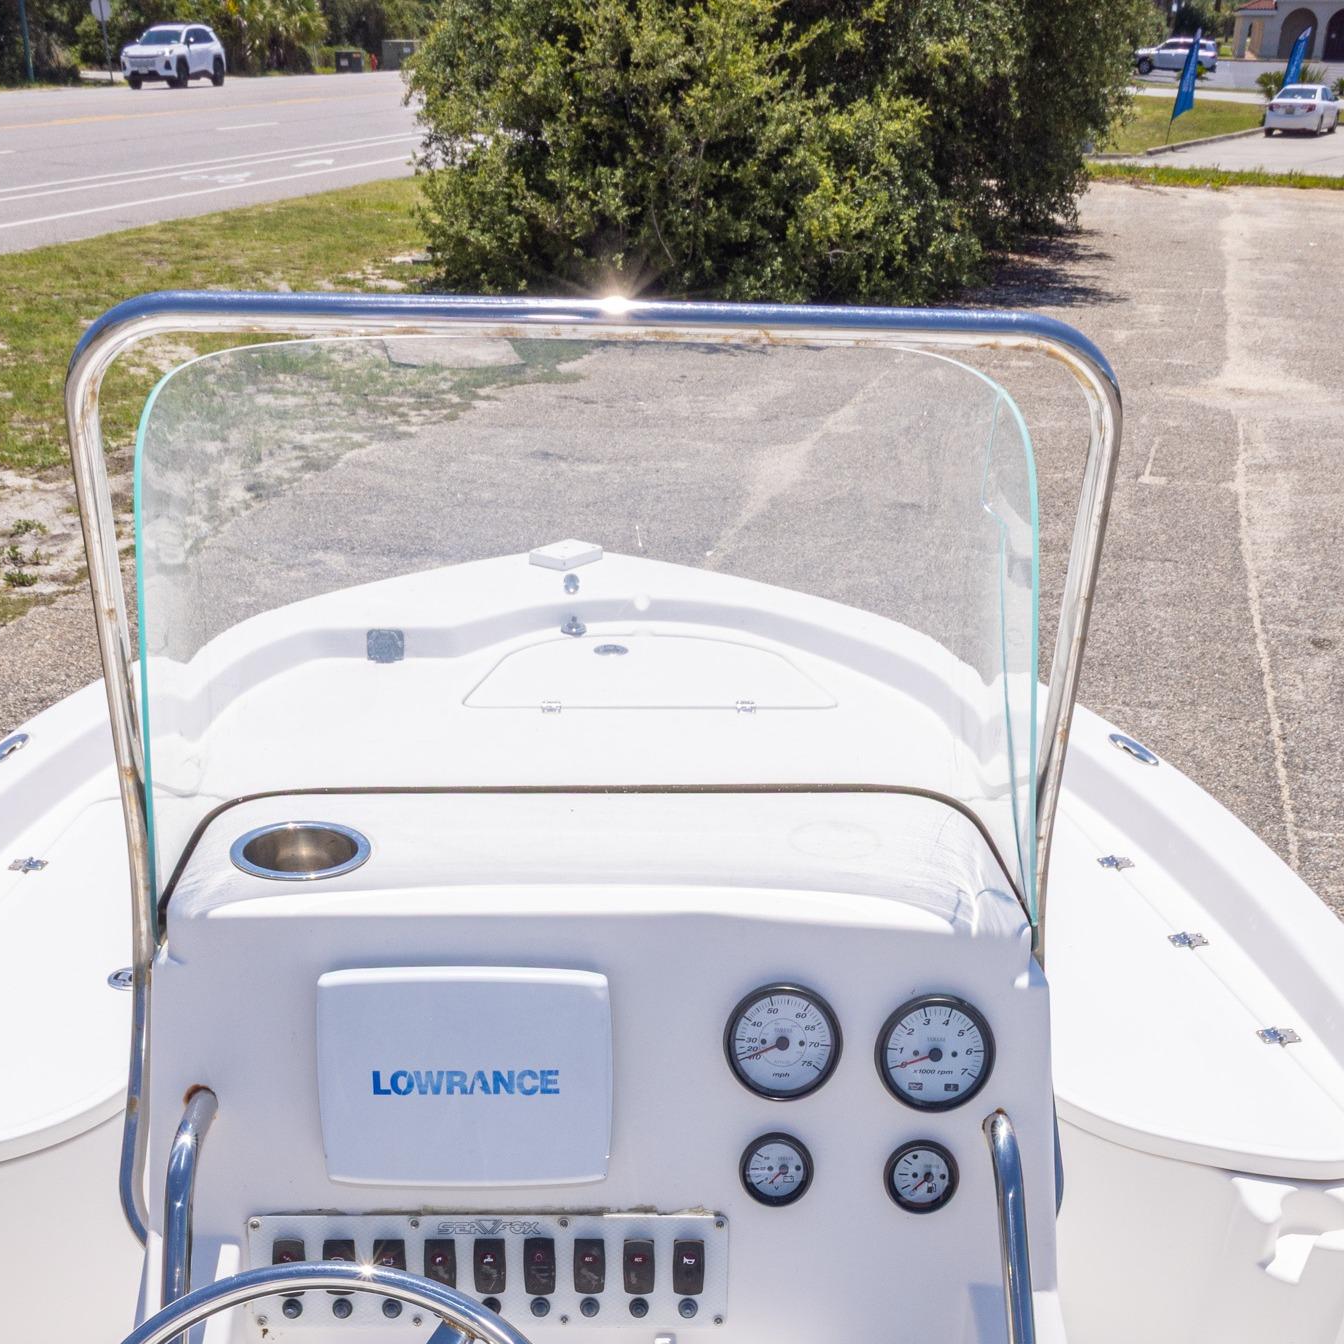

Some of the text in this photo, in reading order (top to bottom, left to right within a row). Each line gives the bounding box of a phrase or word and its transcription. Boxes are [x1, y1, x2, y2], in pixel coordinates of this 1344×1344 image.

[923, 1018, 931, 1026] 3
[907, 1028, 915, 1036] 2
[371, 1069, 560, 1096] LOWRANCE
